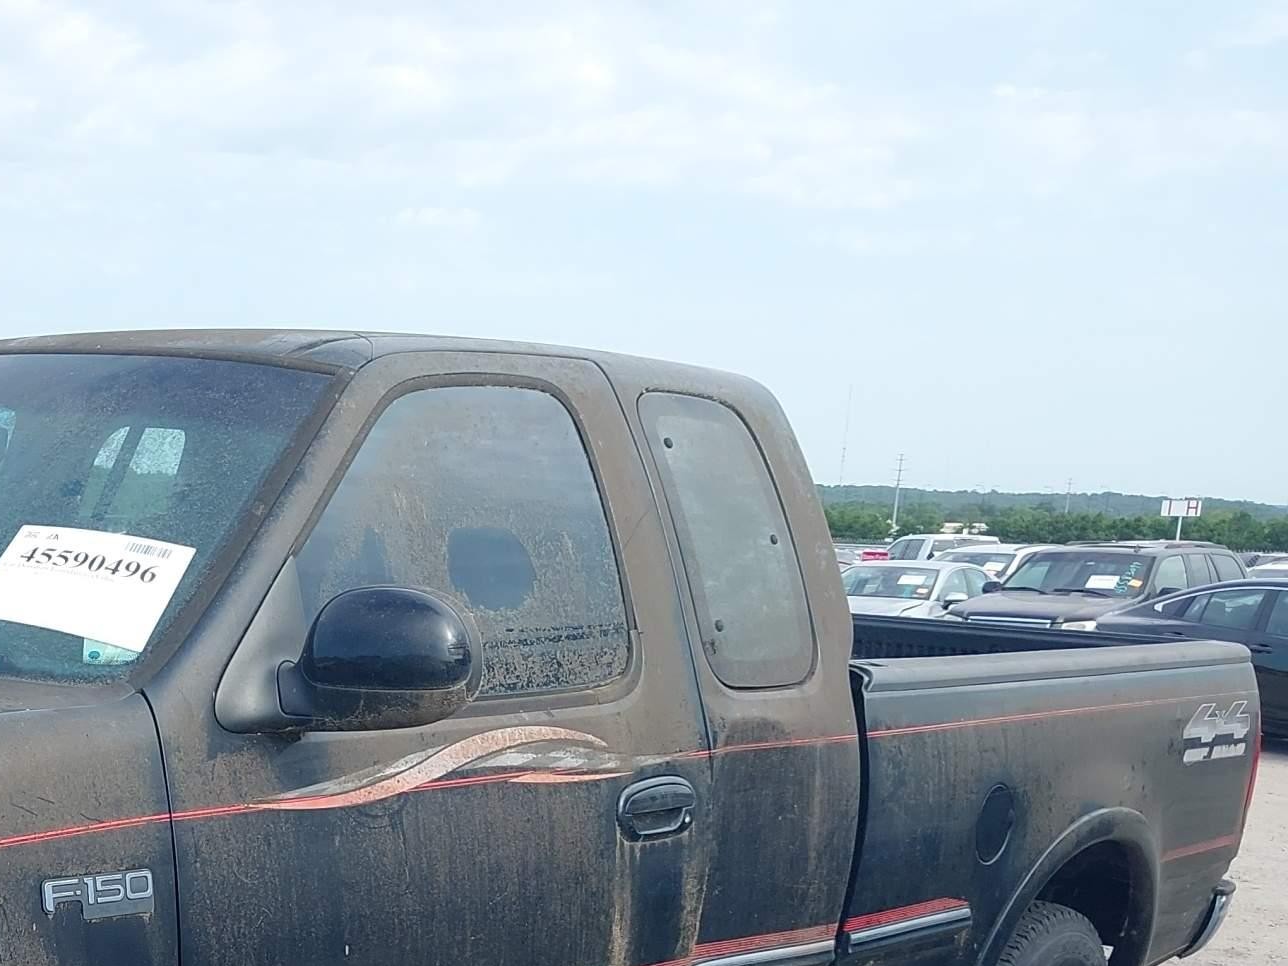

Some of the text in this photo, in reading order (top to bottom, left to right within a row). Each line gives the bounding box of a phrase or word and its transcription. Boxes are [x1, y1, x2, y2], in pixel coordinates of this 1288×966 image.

[1186, 500, 1199, 515] H
[20, 547, 160, 583] 45590496
[1183, 700, 1250, 743] 4x4
